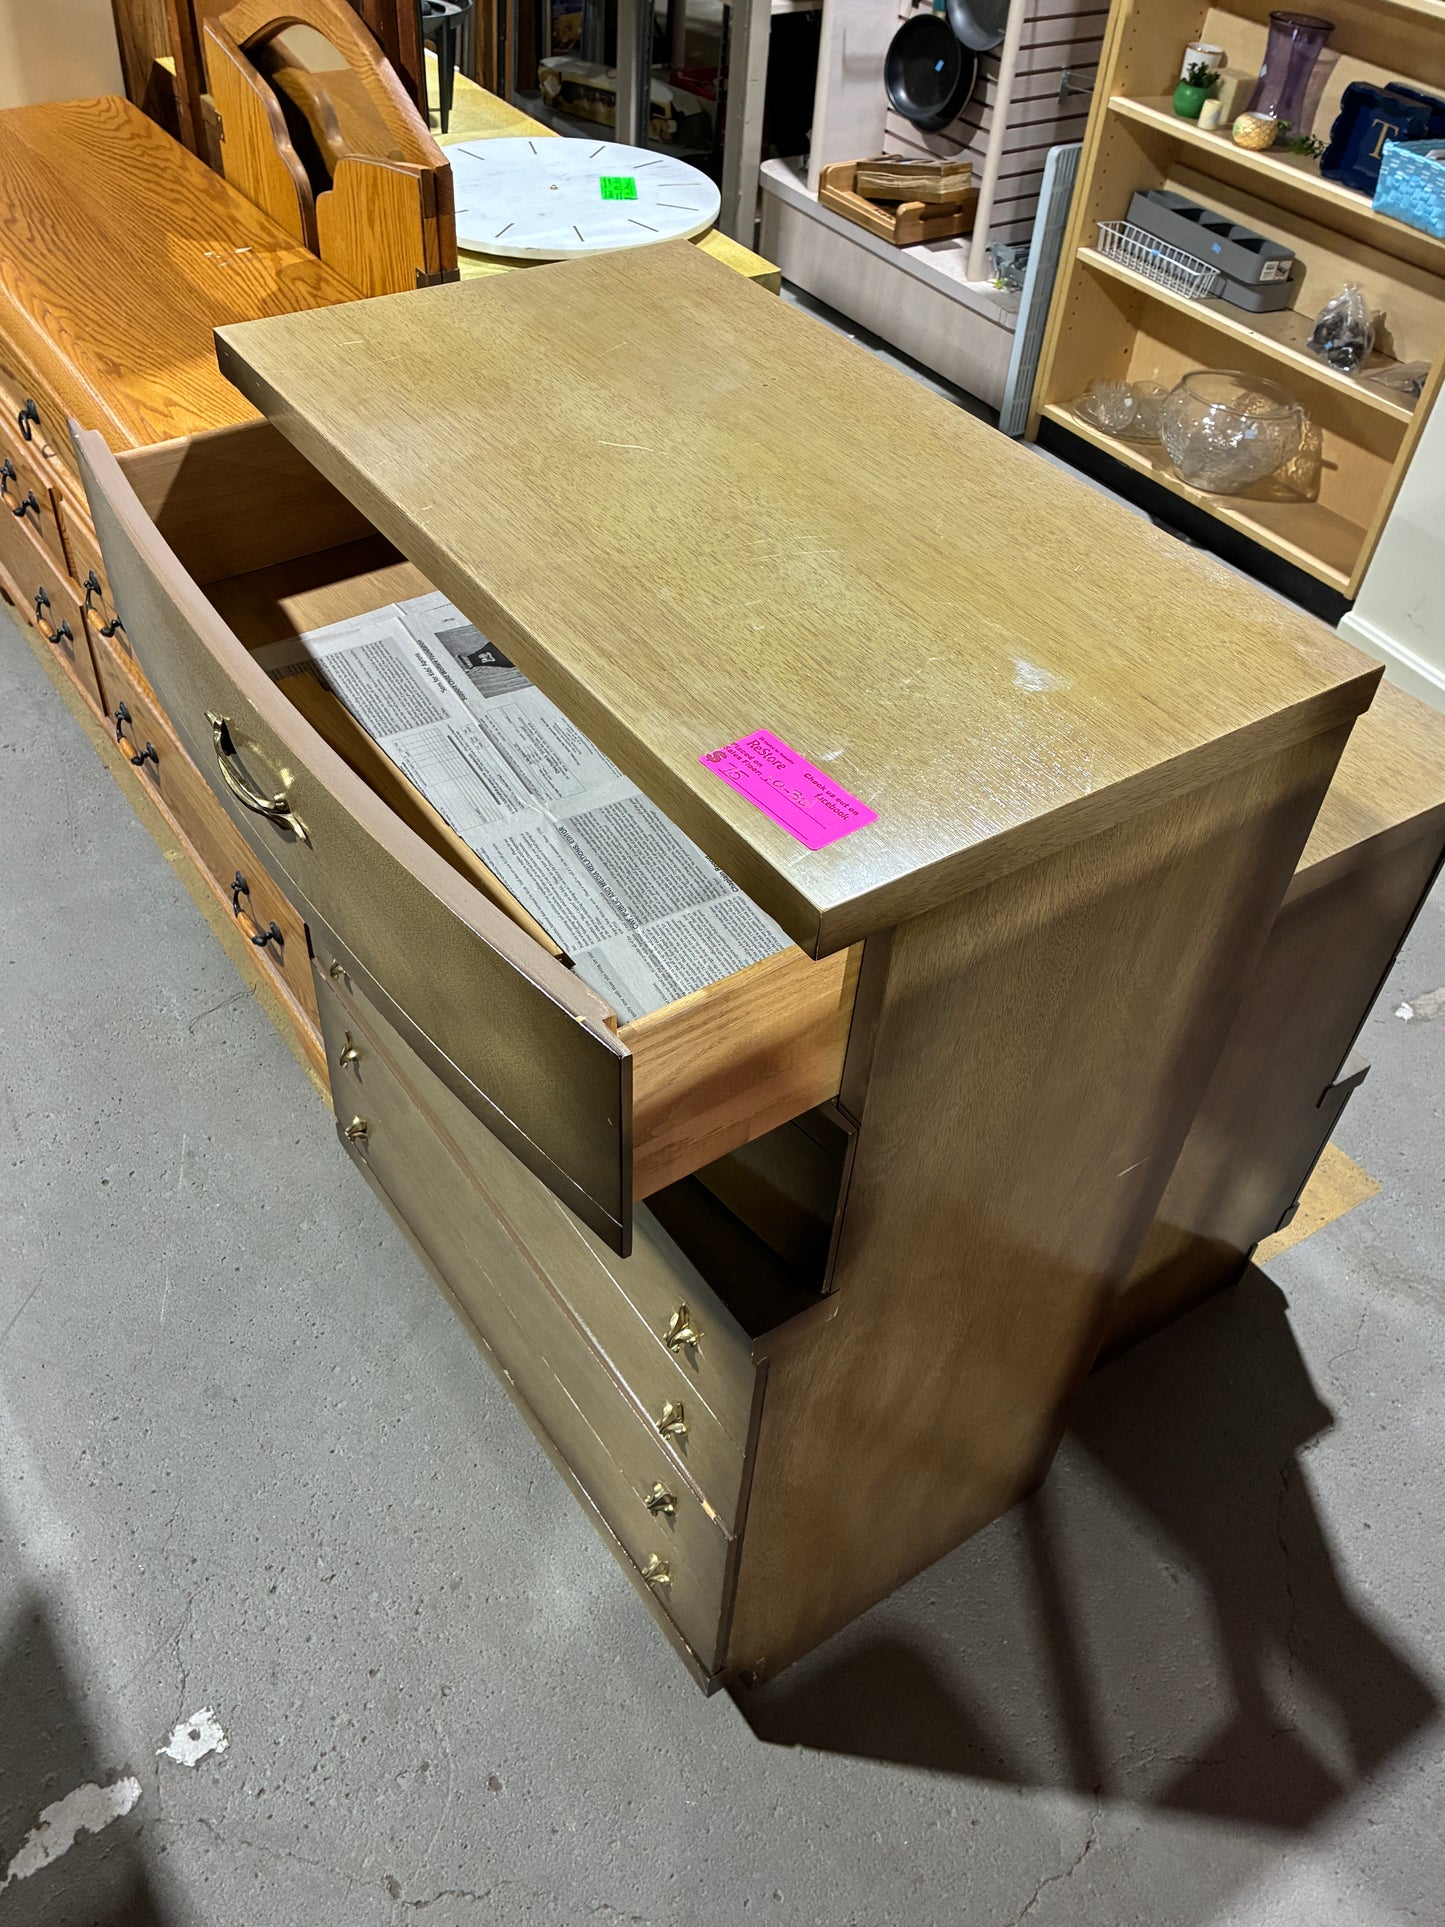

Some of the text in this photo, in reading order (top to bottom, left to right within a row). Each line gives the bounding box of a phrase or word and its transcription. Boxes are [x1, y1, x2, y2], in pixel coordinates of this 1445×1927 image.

[1368, 118, 1399, 160] T
[705, 750, 728, 764] $
[723, 745, 743, 761] Sales
[730, 742, 754, 762] Placed
[752, 759, 764, 767] on
[746, 739, 786, 770] ReStore
[803, 772, 860, 816] Check us out on
[814, 792, 851, 821] facebook
[558, 825, 576, 844] EDITOR
[591, 870, 607, 887] MEDIA
[719, 871, 739, 892] Chaplain
[603, 886, 616, 898] AND
[611, 897, 628, 917] PUBLIC
